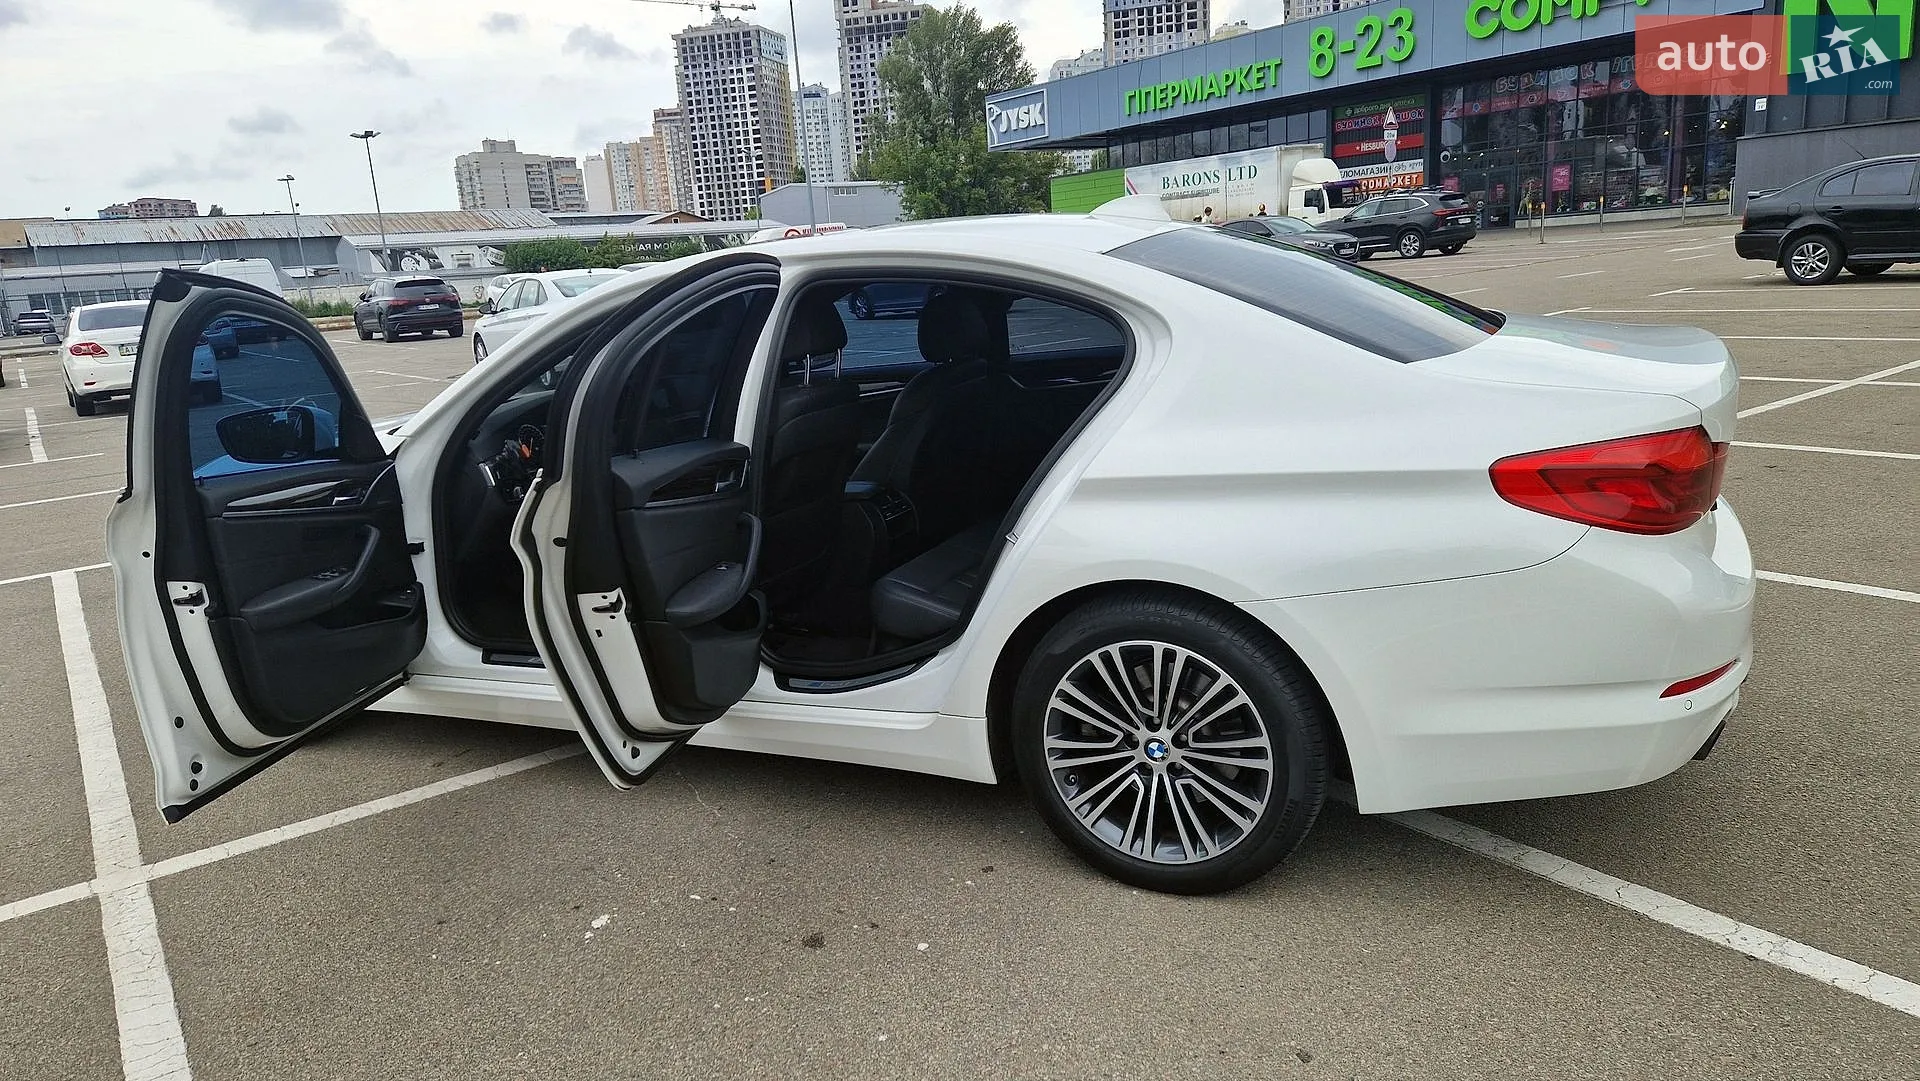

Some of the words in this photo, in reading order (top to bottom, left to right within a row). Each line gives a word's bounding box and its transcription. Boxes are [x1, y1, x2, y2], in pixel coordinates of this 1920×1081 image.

[1309, 7, 1416, 78] 8-23
[1125, 58, 1283, 116] ГІПЕРМАРКЕТ
[1000, 102, 1045, 133] JYSK
[1162, 169, 1221, 190] BARONS
[1228, 164, 1258, 182] LTD
[1359, 175, 1418, 190] ООМАРКЕТ
